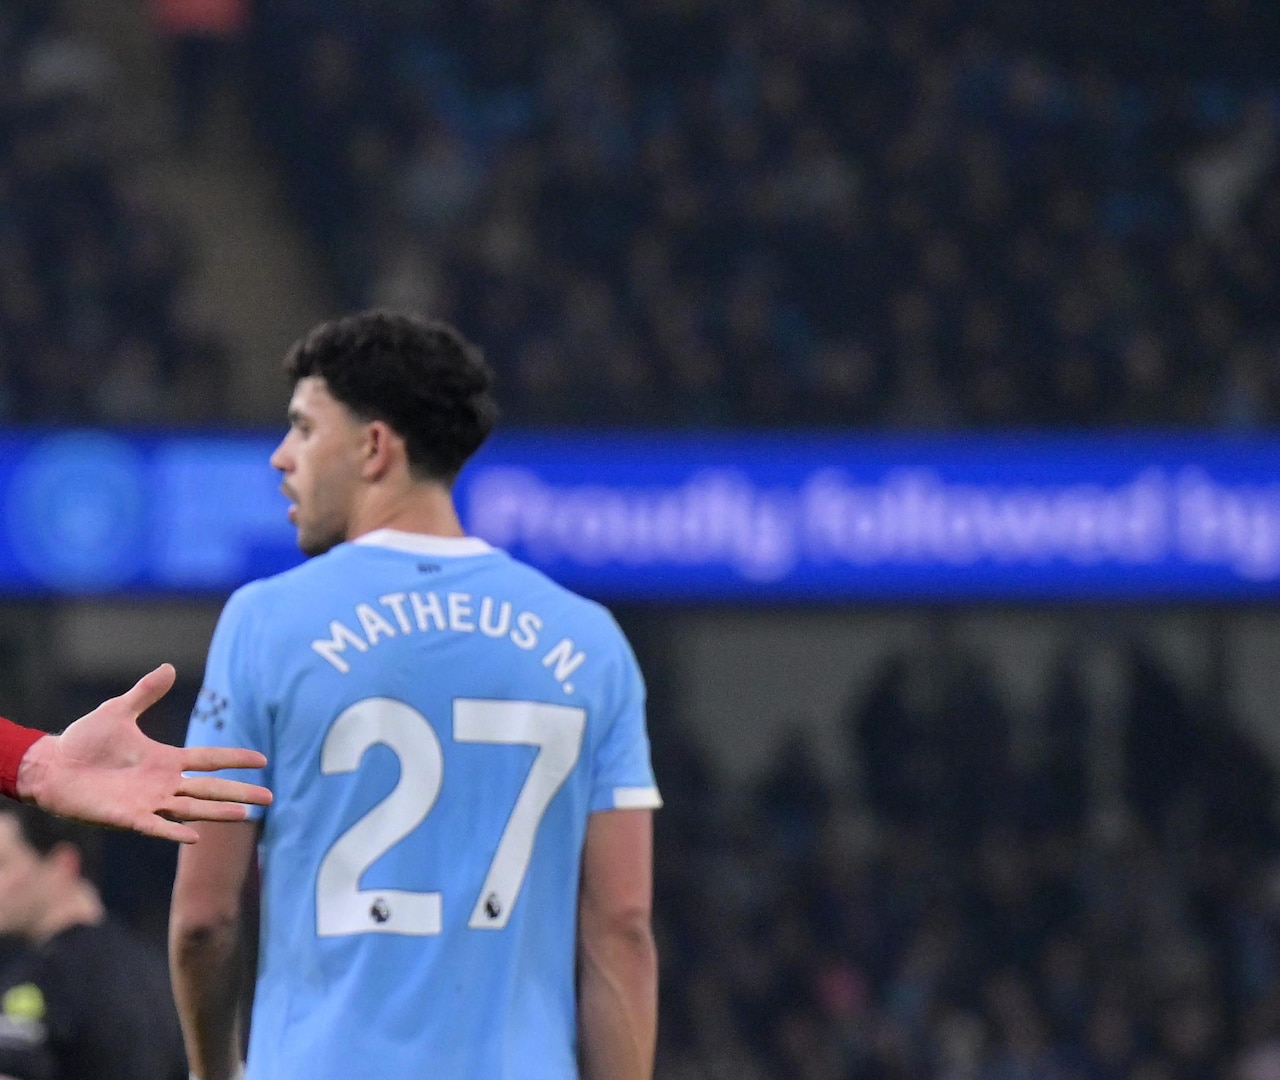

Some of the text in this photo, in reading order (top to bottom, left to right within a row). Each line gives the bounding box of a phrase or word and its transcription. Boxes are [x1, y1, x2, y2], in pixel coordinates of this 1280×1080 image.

[468, 465, 794, 582] Proudly
[802, 465, 1166, 567] followed
[311, 592, 587, 694] MATHEUS N.
[316, 697, 586, 937] 27
